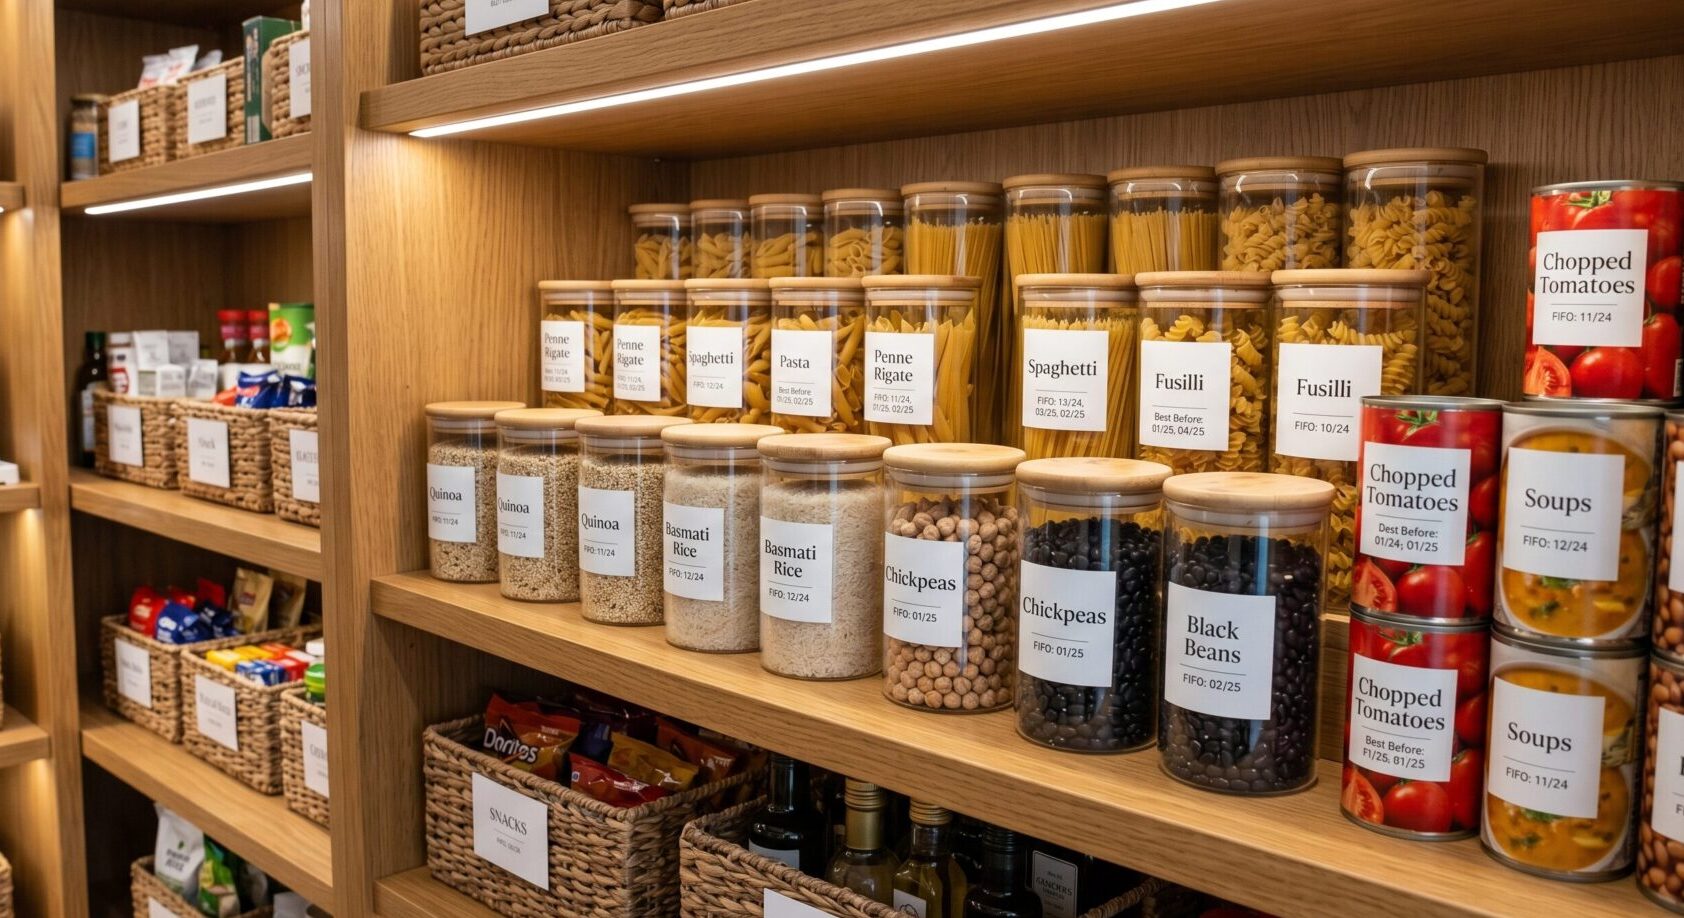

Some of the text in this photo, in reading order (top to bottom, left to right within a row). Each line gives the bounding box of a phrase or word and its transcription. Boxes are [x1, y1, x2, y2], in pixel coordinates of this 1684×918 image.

[1543, 250, 1632, 276] Chopped
[1540, 276, 1635, 294] Tomatoes
[1552, 311, 1612, 323] FIFO: 11/24
[544, 332, 570, 345] Penne
[617, 338, 644, 351] Penne
[544, 346, 571, 361] Rigate
[617, 352, 645, 368] Rigate
[688, 350, 734, 367] Spaghetti
[780, 354, 810, 369] Pasta
[875, 349, 913, 365] Penne
[874, 366, 913, 385] Rigate
[1028, 358, 1097, 379] Spaghetti
[1155, 372, 1204, 391] Fusilli
[1297, 378, 1352, 398] Fusilli
[793, 397, 814, 406] 02/25
[891, 395, 912, 404] 11/24,
[1037, 396, 1056, 406] FIFO:
[892, 405, 914, 414] 02/25
[1060, 408, 1085, 419] 02/25
[1154, 412, 1204, 425] Best Before:
[1152, 424, 1205, 437] 01/25, 04/25
[1295, 420, 1350, 434] FIFO: 10/24
[1370, 463, 1457, 491] Chopped
[430, 486, 462, 501] Quinoa
[1366, 485, 1459, 512] Tomatoes
[1525, 488, 1592, 517] Soups
[498, 497, 530, 514] Quinoa
[581, 512, 620, 531] Quinoa
[666, 521, 710, 542] Basmati
[1401, 526, 1439, 539] Before:
[597, 546, 615, 557] 11/24
[673, 541, 698, 558] Rice
[765, 539, 817, 561] Basmati
[1407, 540, 1439, 552] 01/25
[1523, 535, 1588, 553] FIFO: 12/24
[684, 570, 704, 582] 12/24
[774, 560, 803, 578] Rice
[885, 565, 957, 593] Chickpeas
[769, 588, 810, 603] FIFO: 12/24
[893, 606, 937, 623] FIFO: 01/25
[1023, 596, 1107, 626] Chickpeas
[1187, 614, 1240, 640] Black
[1033, 640, 1084, 658] FIFO: 01/25
[1185, 637, 1241, 664] Beans
[1183, 673, 1242, 693] FIFO: 02/25
[1359, 676, 1442, 709] Chopped
[1355, 697, 1445, 731] Tomatoes
[483, 727, 539, 764] Doritos
[1365, 735, 1425, 756] Best Before:
[1507, 721, 1572, 754] Soups
[1505, 767, 1568, 790] FIFO: 11/24
[489, 807, 528, 836] SNACKS
